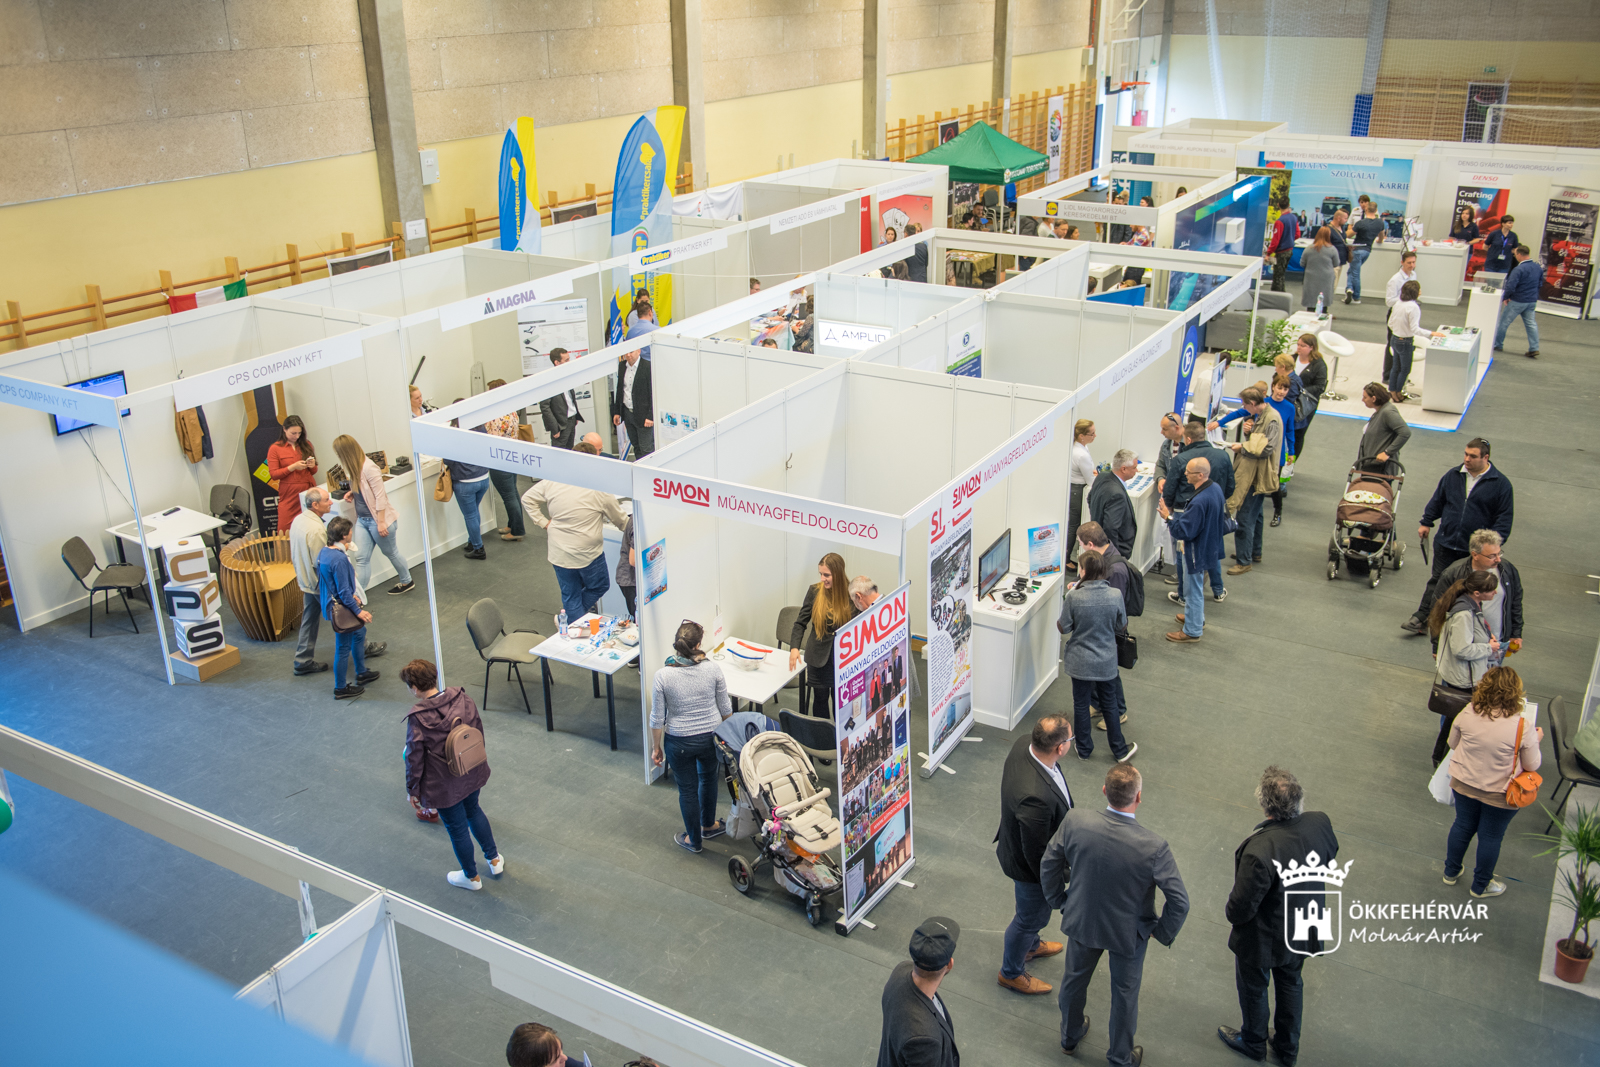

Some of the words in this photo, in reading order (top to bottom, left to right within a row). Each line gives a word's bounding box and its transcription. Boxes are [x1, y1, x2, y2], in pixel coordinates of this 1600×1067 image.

[1331, 170, 1378, 180] SZOLGÁLAT
[1480, 161, 1504, 169] GYÁRTÓ
[1505, 163, 1555, 172] MAGYARORSZÁG
[1458, 190, 1493, 200] Crafting
[1562, 190, 1589, 199] DENSO
[778, 215, 797, 226] NEMZETI
[1064, 211, 1108, 220] KERESKEDELMI
[1078, 206, 1127, 215] MAGYARORSZÁG
[1548, 216, 1583, 226] Technology
[1549, 209, 1587, 219] Automotive
[642, 251, 670, 265] Praktiker
[673, 242, 702, 256] PRAKTIKER
[703, 238, 713, 247] KFT
[496, 290, 536, 311] MAGNA
[228, 372, 250, 386] CPS
[252, 356, 302, 378] COMPANY
[304, 350, 323, 363] KFT
[0, 384, 17, 396] CPS
[18, 388, 60, 406] COMPANY
[62, 398, 78, 410] KFT
[490, 446, 519, 463] LITZE
[522, 453, 542, 468] KFT
[952, 471, 981, 509] SIMON
[984, 425, 1048, 483] MŰANYAGFELDOLGOZÓ
[653, 478, 710, 507] SIMON
[718, 495, 878, 540] MŰANYAGFELDOLGOZÓ
[839, 591, 906, 669] SIMON
[931, 669, 972, 718] WWW.SIMONCEG.HU
[874, 796, 907, 830] www.simonceg.hu
